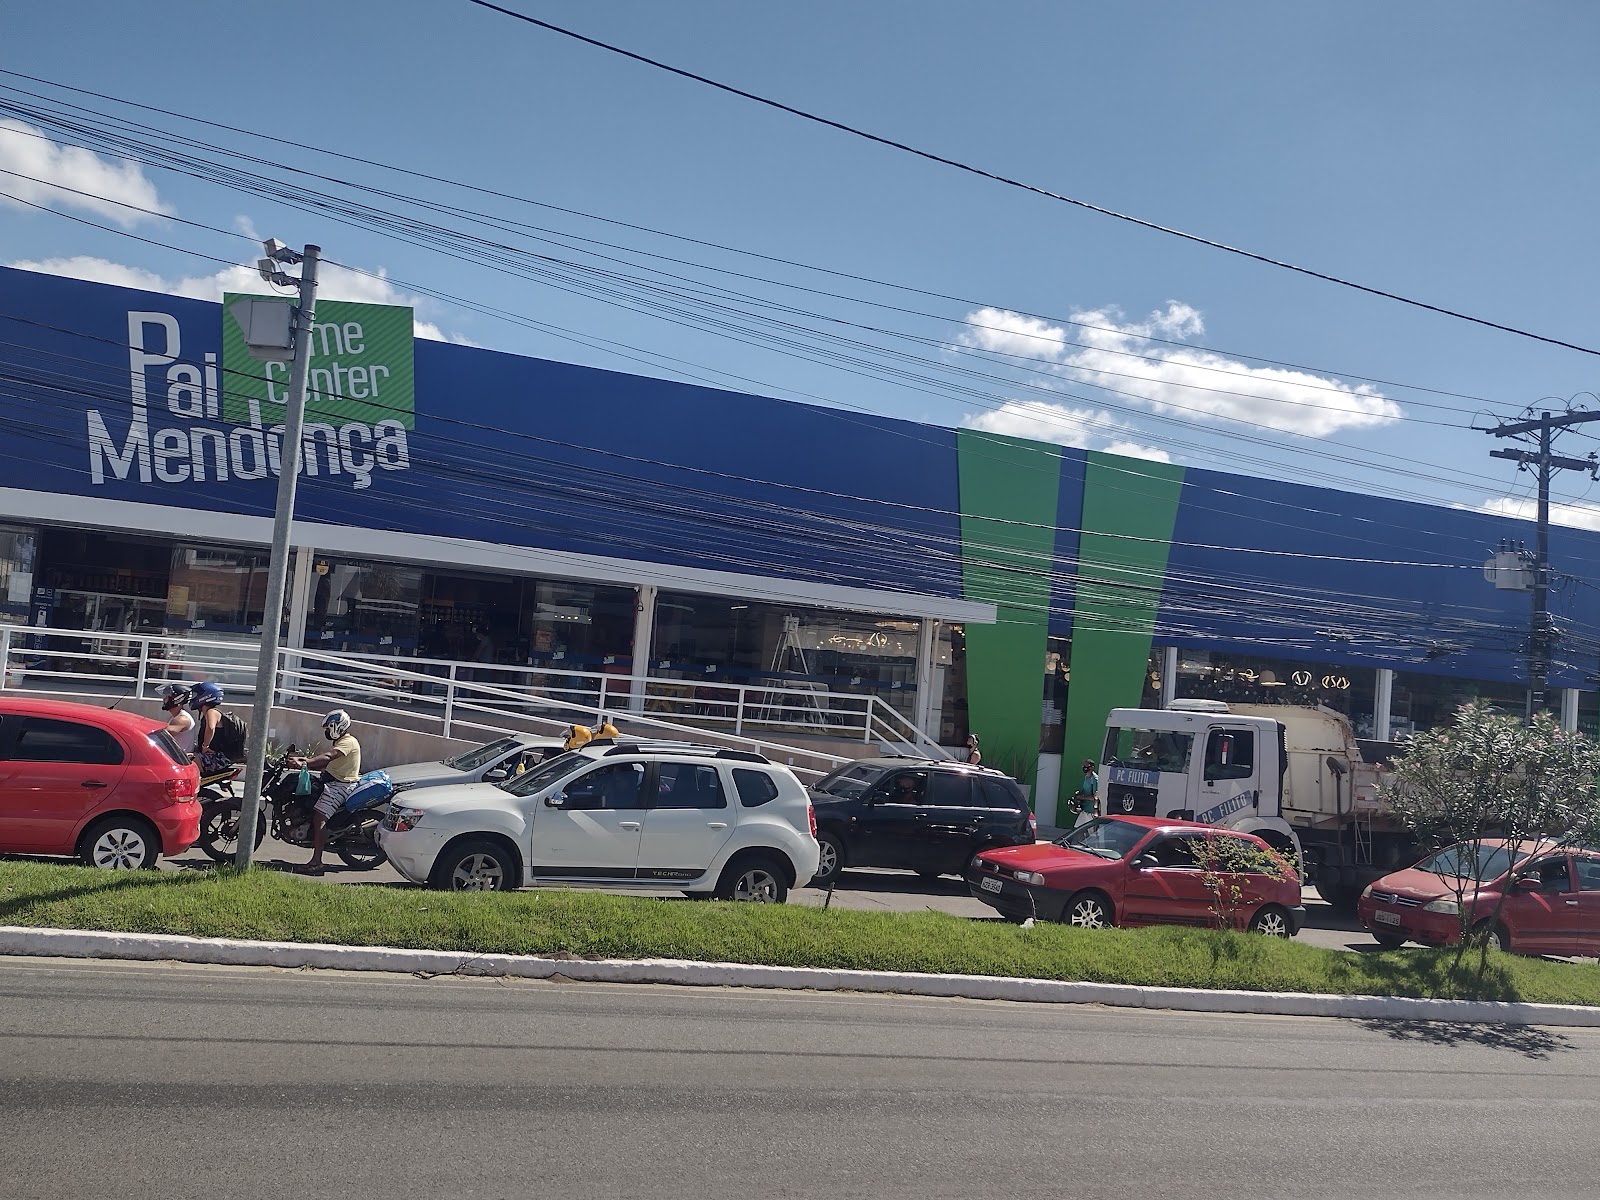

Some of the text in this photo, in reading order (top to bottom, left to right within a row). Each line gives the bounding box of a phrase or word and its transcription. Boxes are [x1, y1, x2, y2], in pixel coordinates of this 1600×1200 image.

[127, 311, 218, 420] Pai
[265, 361, 390, 405] Cnter
[1219, 794, 1247, 818] FILITO
